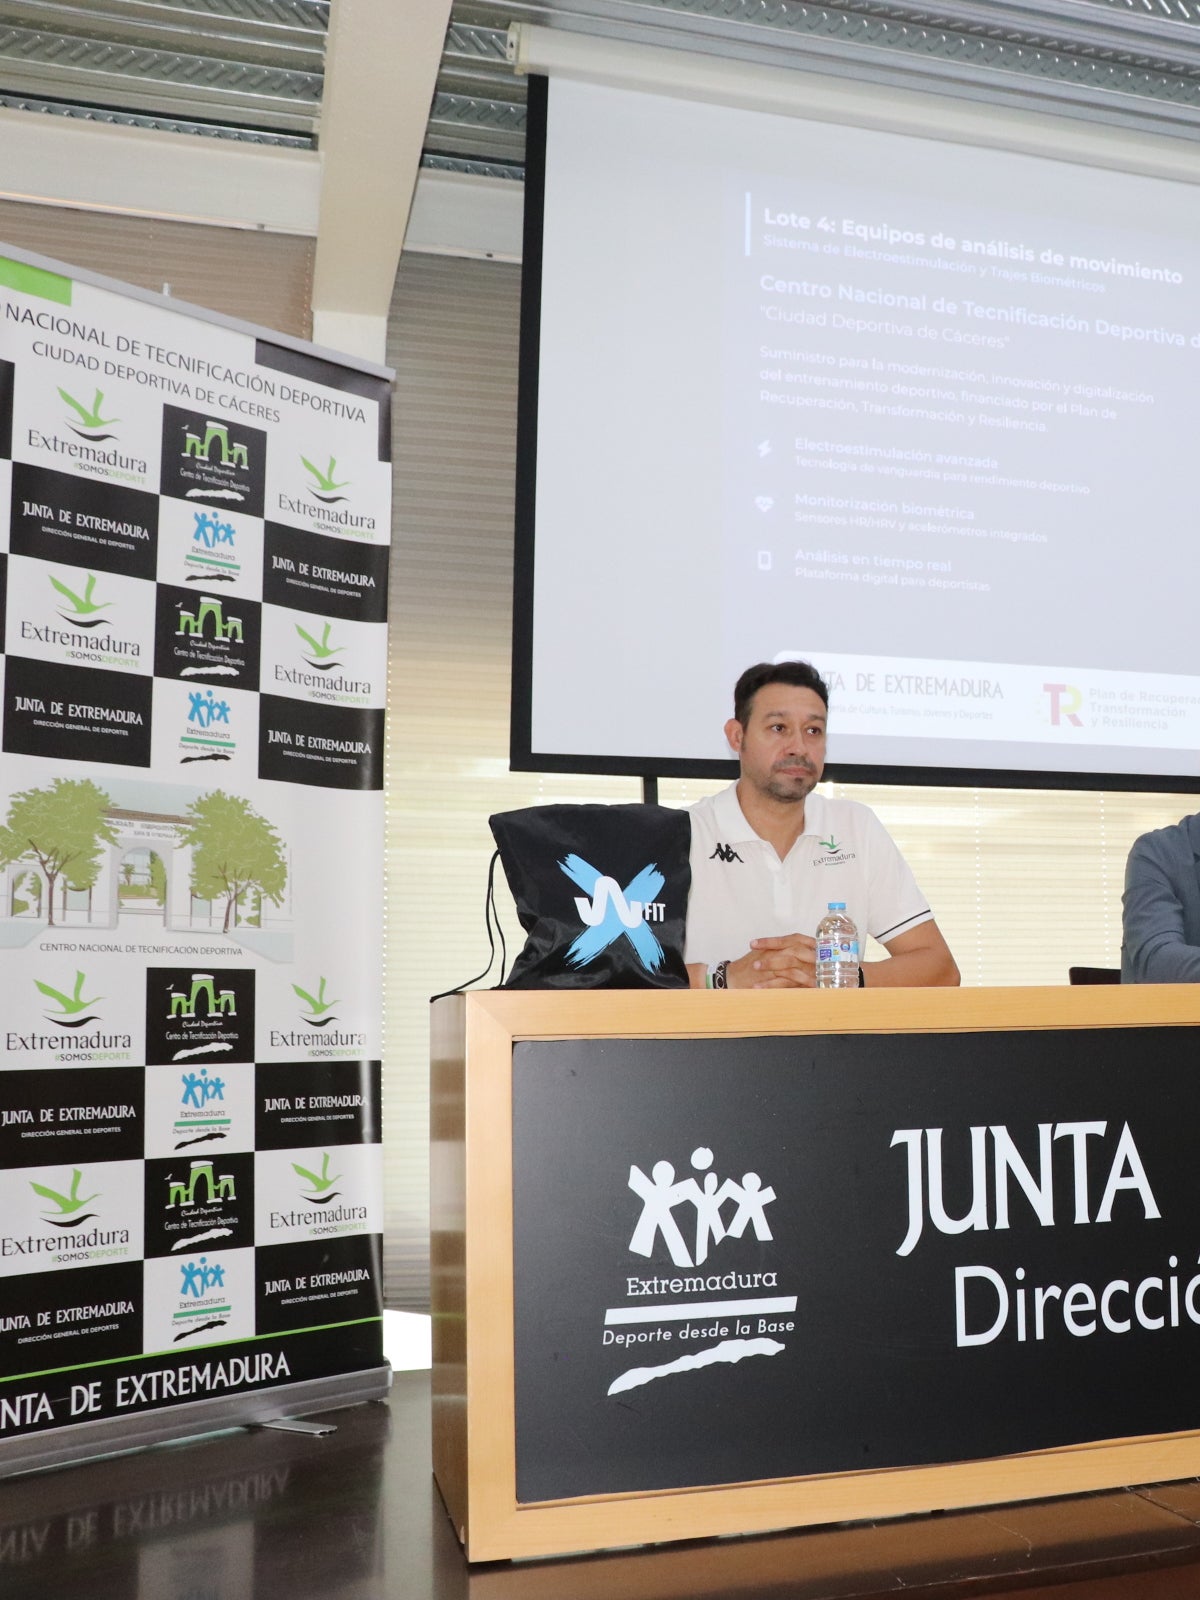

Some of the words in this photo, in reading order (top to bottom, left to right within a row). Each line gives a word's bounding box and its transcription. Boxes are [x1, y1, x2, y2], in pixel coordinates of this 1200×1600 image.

[764, 207, 810, 229] Lote
[816, 217, 836, 233] 4:
[842, 219, 925, 246] Equipos
[931, 232, 956, 250] de
[961, 238, 1034, 262] análisis
[1040, 248, 1064, 266] de
[1070, 255, 1183, 284] movimiento
[763, 234, 819, 252] Sistema
[823, 242, 840, 255] de
[979, 265, 988, 277] y
[990, 266, 1028, 281] Trajes
[1031, 271, 1106, 293] Biométricos
[760, 275, 832, 298] Centro
[838, 285, 926, 310] Nacional
[932, 297, 958, 314] de
[964, 300, 1089, 332] Tecnificación
[1095, 319, 1185, 346] Deportiva
[832, 313, 913, 337] Deportiva
[917, 324, 938, 340] de
[6, 303, 110, 347] NACIONAL
[117, 336, 140, 356] DE
[144, 343, 275, 396] TECNIFICACIÓN
[280, 385, 366, 423] DEPORTIVA
[759, 345, 836, 365] Suministro
[839, 356, 869, 369] para
[872, 357, 884, 371] la
[992, 374, 1060, 392] innovación
[1063, 383, 1071, 394] y
[1073, 384, 1154, 403] digitalización
[32, 341, 100, 371] CIUDAD
[104, 361, 191, 398] DEPORTIVA
[196, 387, 215, 404] DE
[218, 392, 280, 423] CÁCERES
[760, 368, 782, 381] del
[785, 372, 888, 393] entrenamiento
[961, 390, 1029, 409] financiado
[1032, 400, 1054, 413] por
[1056, 402, 1067, 414] el
[1071, 404, 1098, 418] Plan
[1101, 408, 1117, 420] de
[862, 400, 964, 423] Transformación
[968, 414, 976, 426] y
[28, 429, 147, 473] Extremadura
[23, 501, 54, 520] JUNTA
[59, 510, 72, 524] DE
[76, 513, 150, 540] EXTREMADURA
[278, 494, 376, 529] Extremadura
[272, 556, 295, 573] JUNTA
[299, 562, 309, 575] DE
[312, 566, 376, 587] EXTREMADURA
[795, 549, 848, 564] Análisis
[852, 555, 870, 565] en
[873, 555, 924, 570] tiempo
[927, 560, 952, 572] real
[21, 621, 140, 657] Extremadura
[274, 665, 371, 694] Extremadura
[856, 673, 875, 692] DE
[884, 674, 1004, 699] EXTREMADURA
[15, 696, 46, 713] JUNTA
[50, 701, 64, 716] DE
[68, 704, 143, 726] EXTREMADURA
[268, 730, 292, 744] JUNTA
[295, 734, 305, 747] DE
[308, 736, 372, 754] EXTREMADURA
[644, 903, 666, 922] FIT
[40, 943, 77, 952] CENTRO
[79, 944, 123, 953] NACIONAL
[125, 945, 137, 953] DE
[139, 945, 199, 954] TECNIFICACIÓN
[200, 947, 242, 956] DEPORTIVA
[6, 1031, 131, 1051] Extremadura
[270, 1030, 366, 1047] Extremadura
[1, 1109, 34, 1126] JUNTA
[40, 1109, 54, 1122] DE
[59, 1105, 136, 1121] EXTREMADURA
[265, 1098, 291, 1112] JUNTA
[295, 1097, 306, 1109] DE
[889, 1120, 1162, 1257] JUNTA
[270, 1205, 367, 1229] Extremadura
[1, 1228, 129, 1256] Extremadura
[265, 1281, 291, 1296] JUNTA
[295, 1277, 307, 1289] DE
[310, 1269, 370, 1288] EXTREMADURA
[626, 1271, 777, 1296] Extremadura
[37, 1312, 51, 1326] DE
[56, 1301, 134, 1323] EXTREMADURA
[602, 1328, 672, 1348] Deporte
[679, 1320, 729, 1340] desde
[735, 1319, 750, 1335] la
[757, 1318, 795, 1334] Base
[0, 1391, 54, 1430] NTA
[71, 1381, 102, 1416] DE
[116, 1351, 291, 1408] EXTREMADURA
